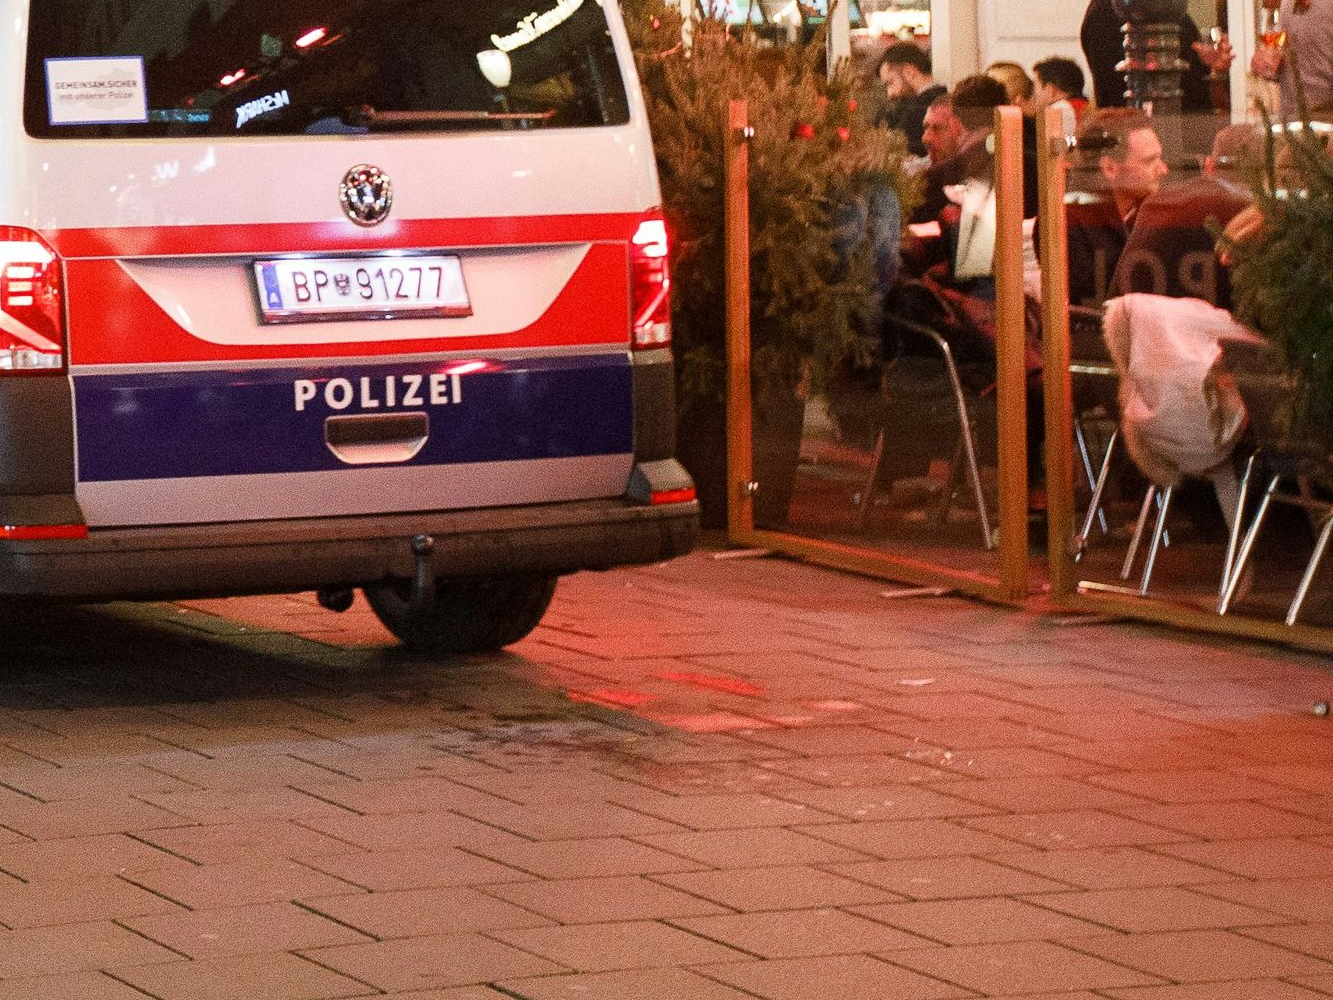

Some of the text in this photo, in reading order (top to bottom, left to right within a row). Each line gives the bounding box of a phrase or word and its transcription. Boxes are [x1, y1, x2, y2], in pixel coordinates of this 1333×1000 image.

[292, 266, 443, 303] BP 91277
[293, 373, 462, 412] POLIZEI
